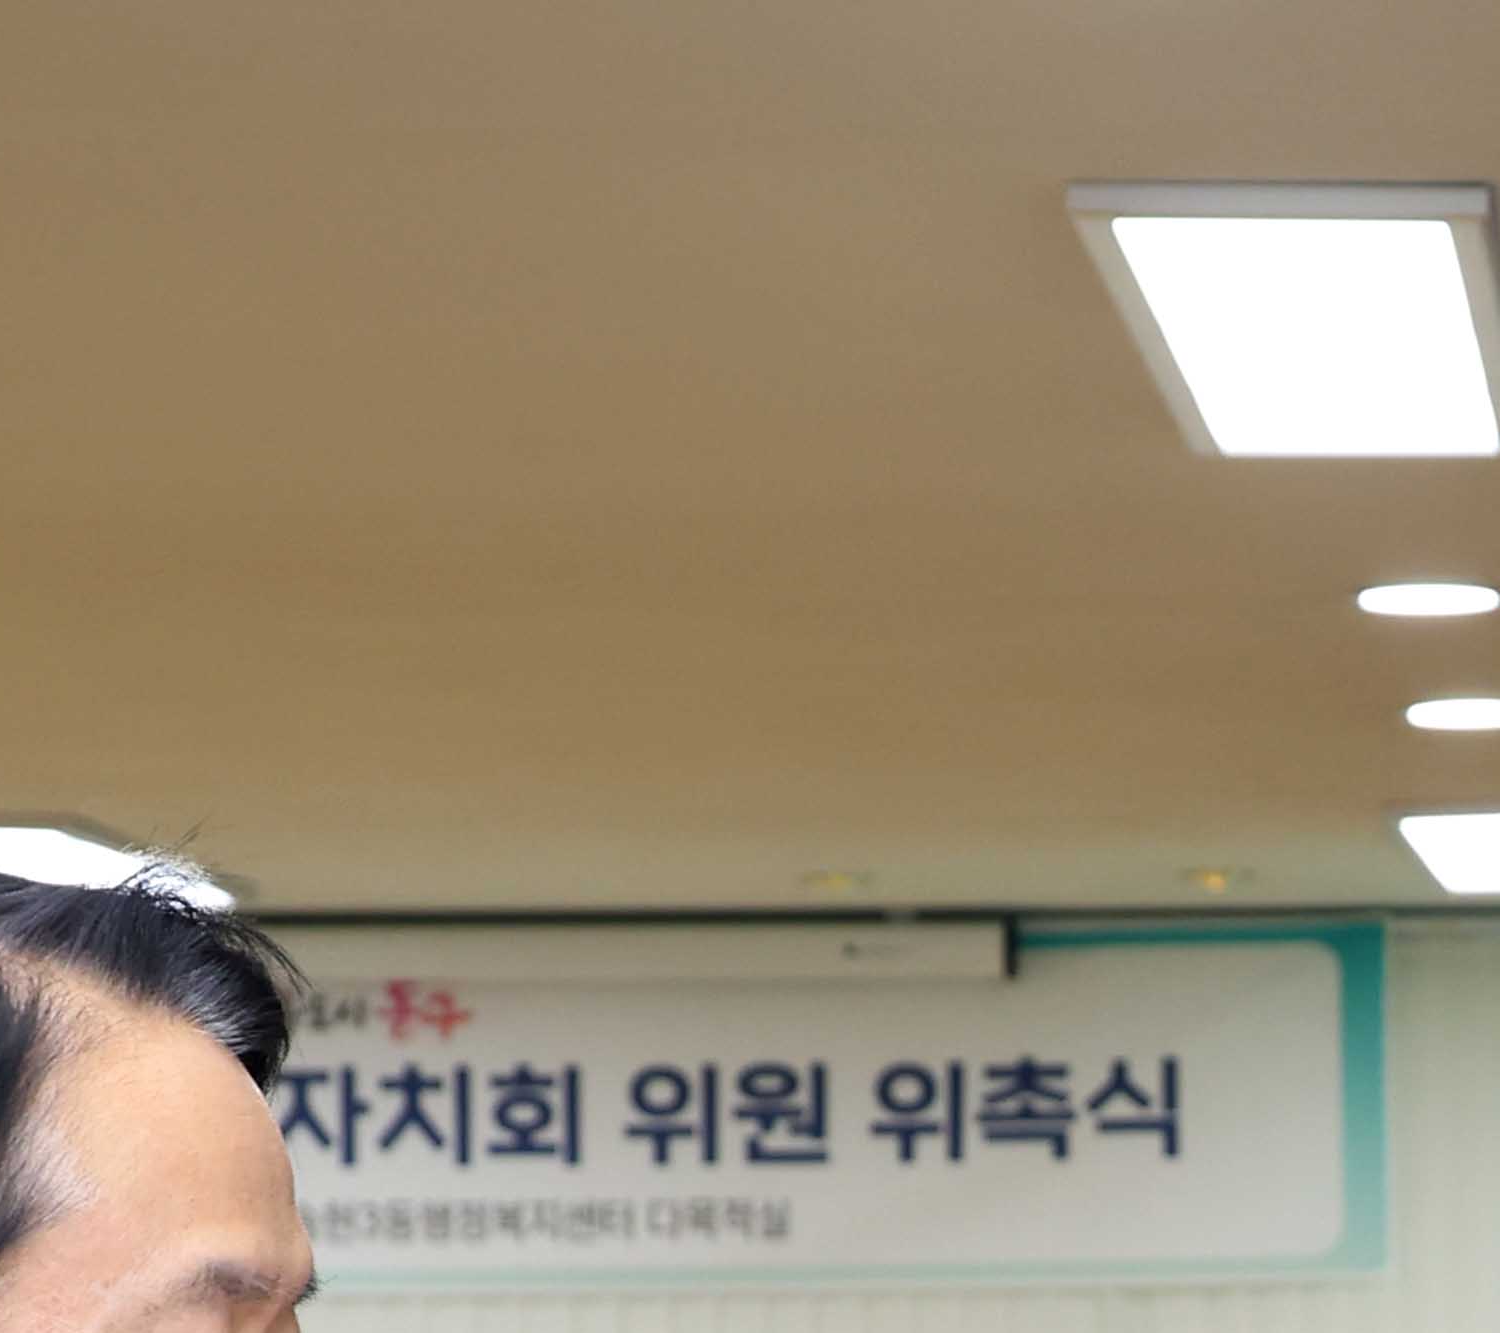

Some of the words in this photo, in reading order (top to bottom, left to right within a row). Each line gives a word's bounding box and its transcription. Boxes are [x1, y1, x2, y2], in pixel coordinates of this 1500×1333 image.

[381, 980, 474, 1040] 동구
[624, 1062, 829, 1165] 위원
[870, 1056, 1179, 1164] 위촉식
